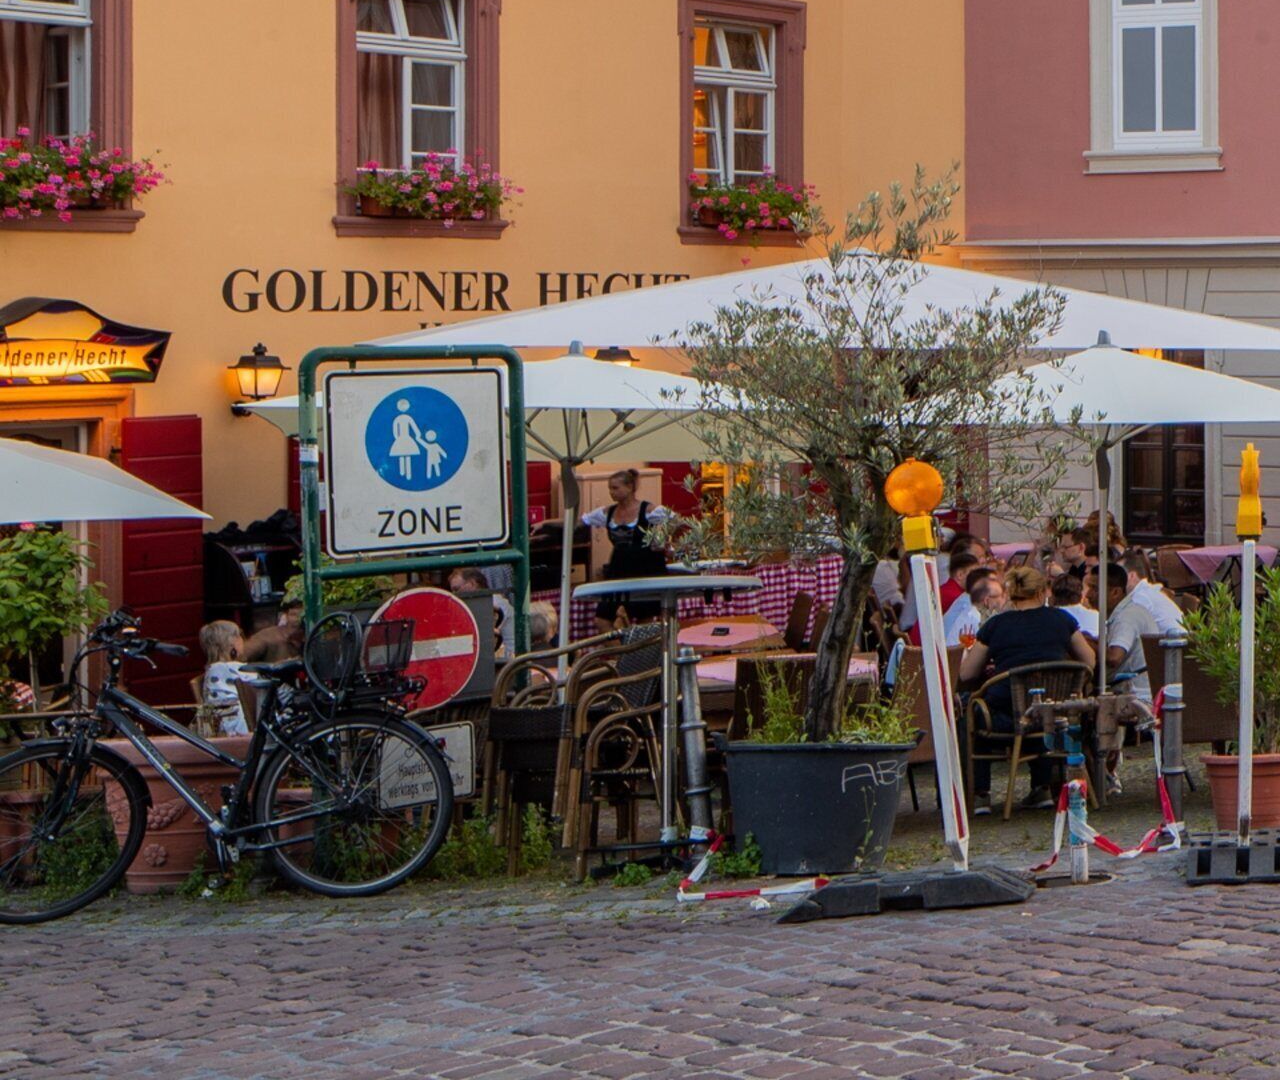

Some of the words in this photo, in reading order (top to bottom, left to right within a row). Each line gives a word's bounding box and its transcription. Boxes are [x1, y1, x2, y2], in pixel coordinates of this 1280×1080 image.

[221, 268, 512, 313] GOLDENER
[0, 349, 68, 367] ldener
[74, 349, 127, 367] Hecht
[378, 505, 463, 538] ZONE
